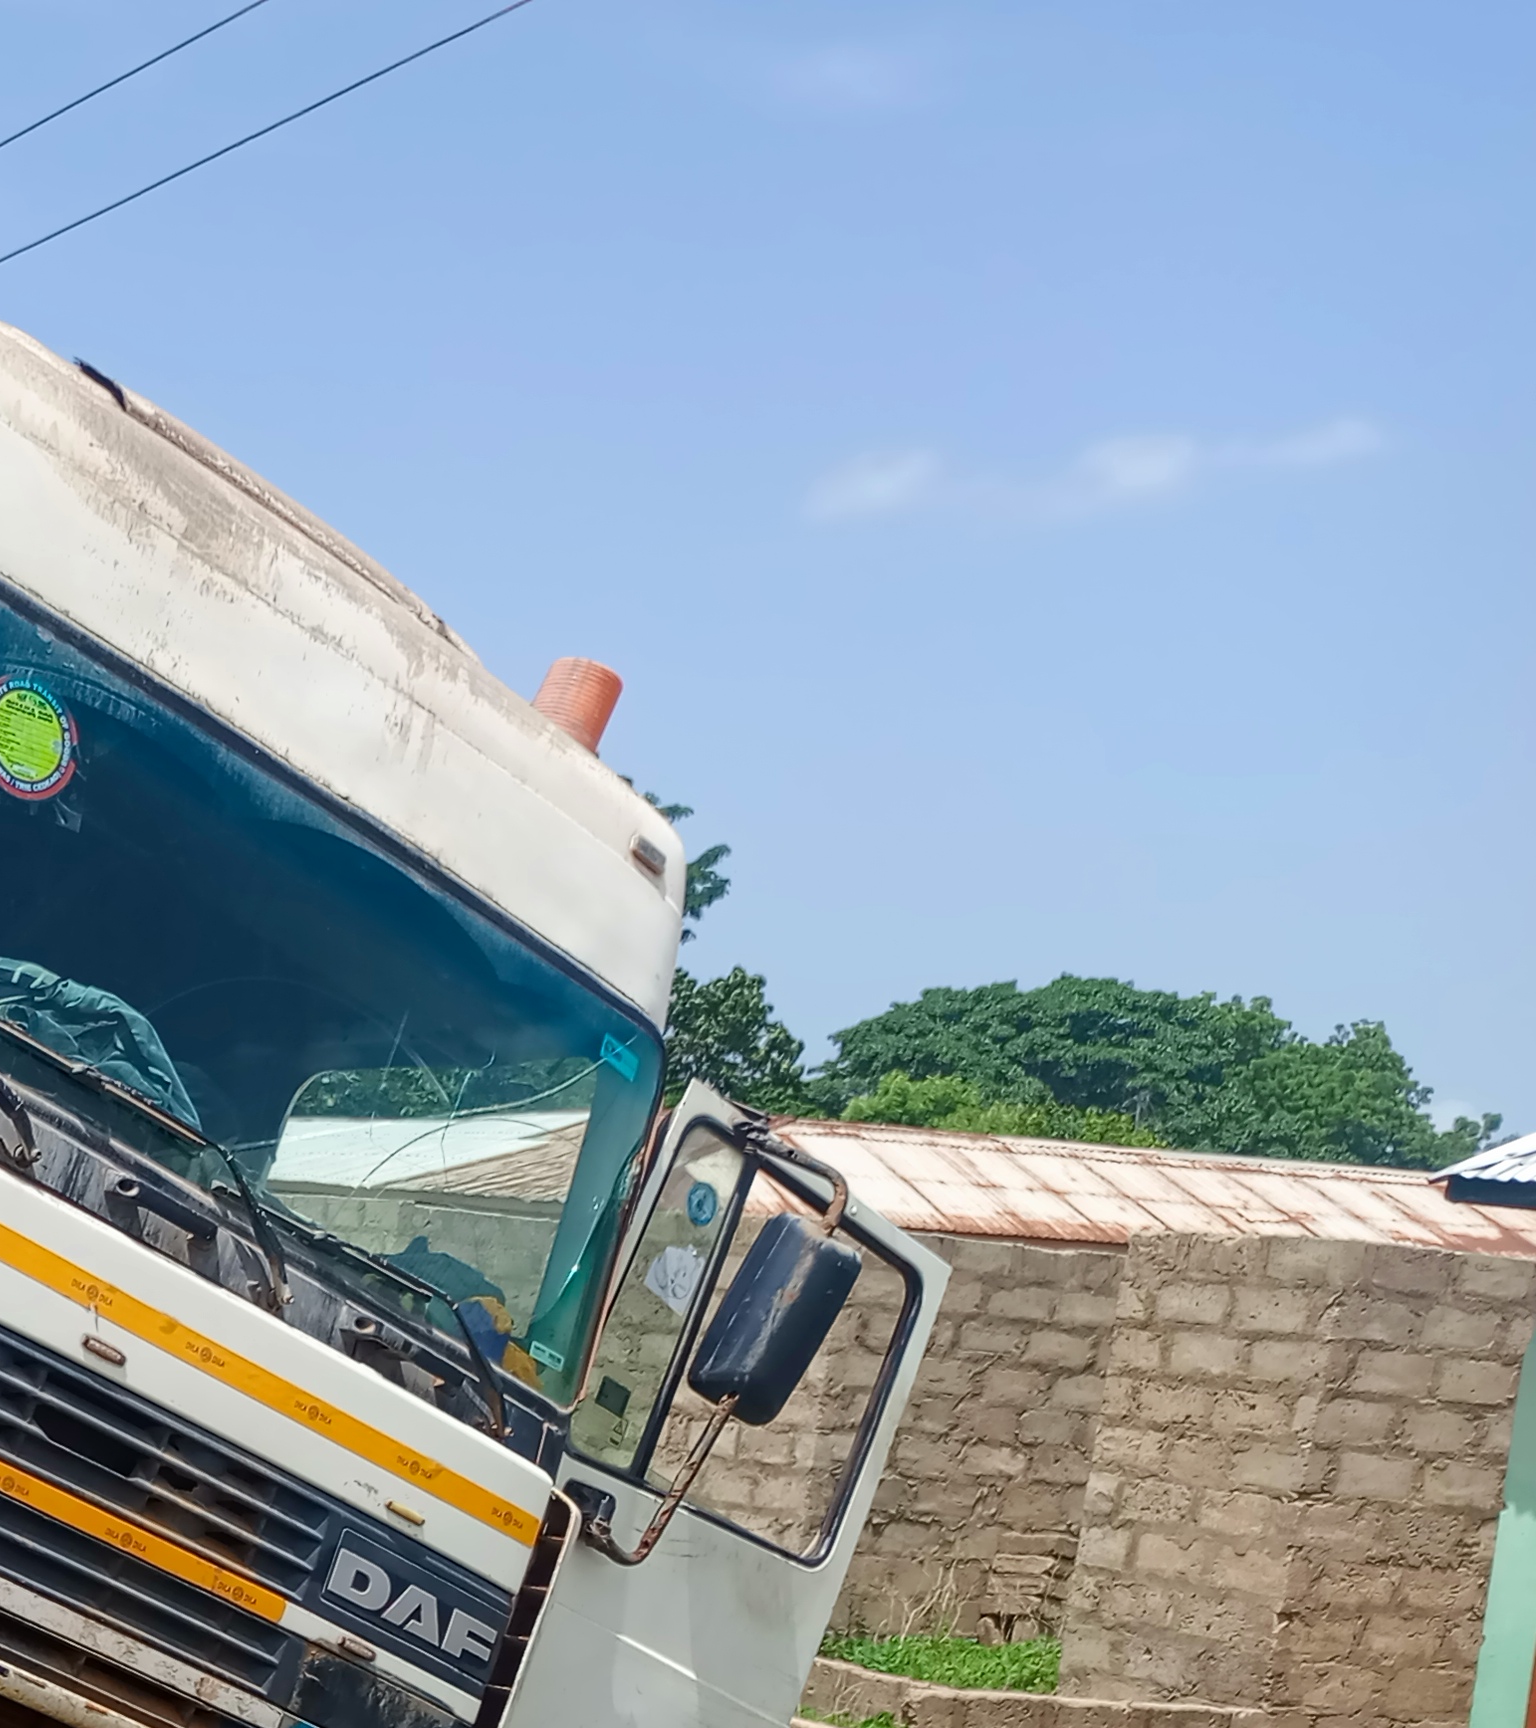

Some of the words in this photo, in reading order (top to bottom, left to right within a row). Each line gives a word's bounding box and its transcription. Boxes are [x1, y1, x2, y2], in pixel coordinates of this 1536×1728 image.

[8, 680, 31, 690] ROAD
[32, 683, 64, 715] TRANSIT
[59, 714, 70, 730] OF
[326, 1547, 499, 1662] DAF
